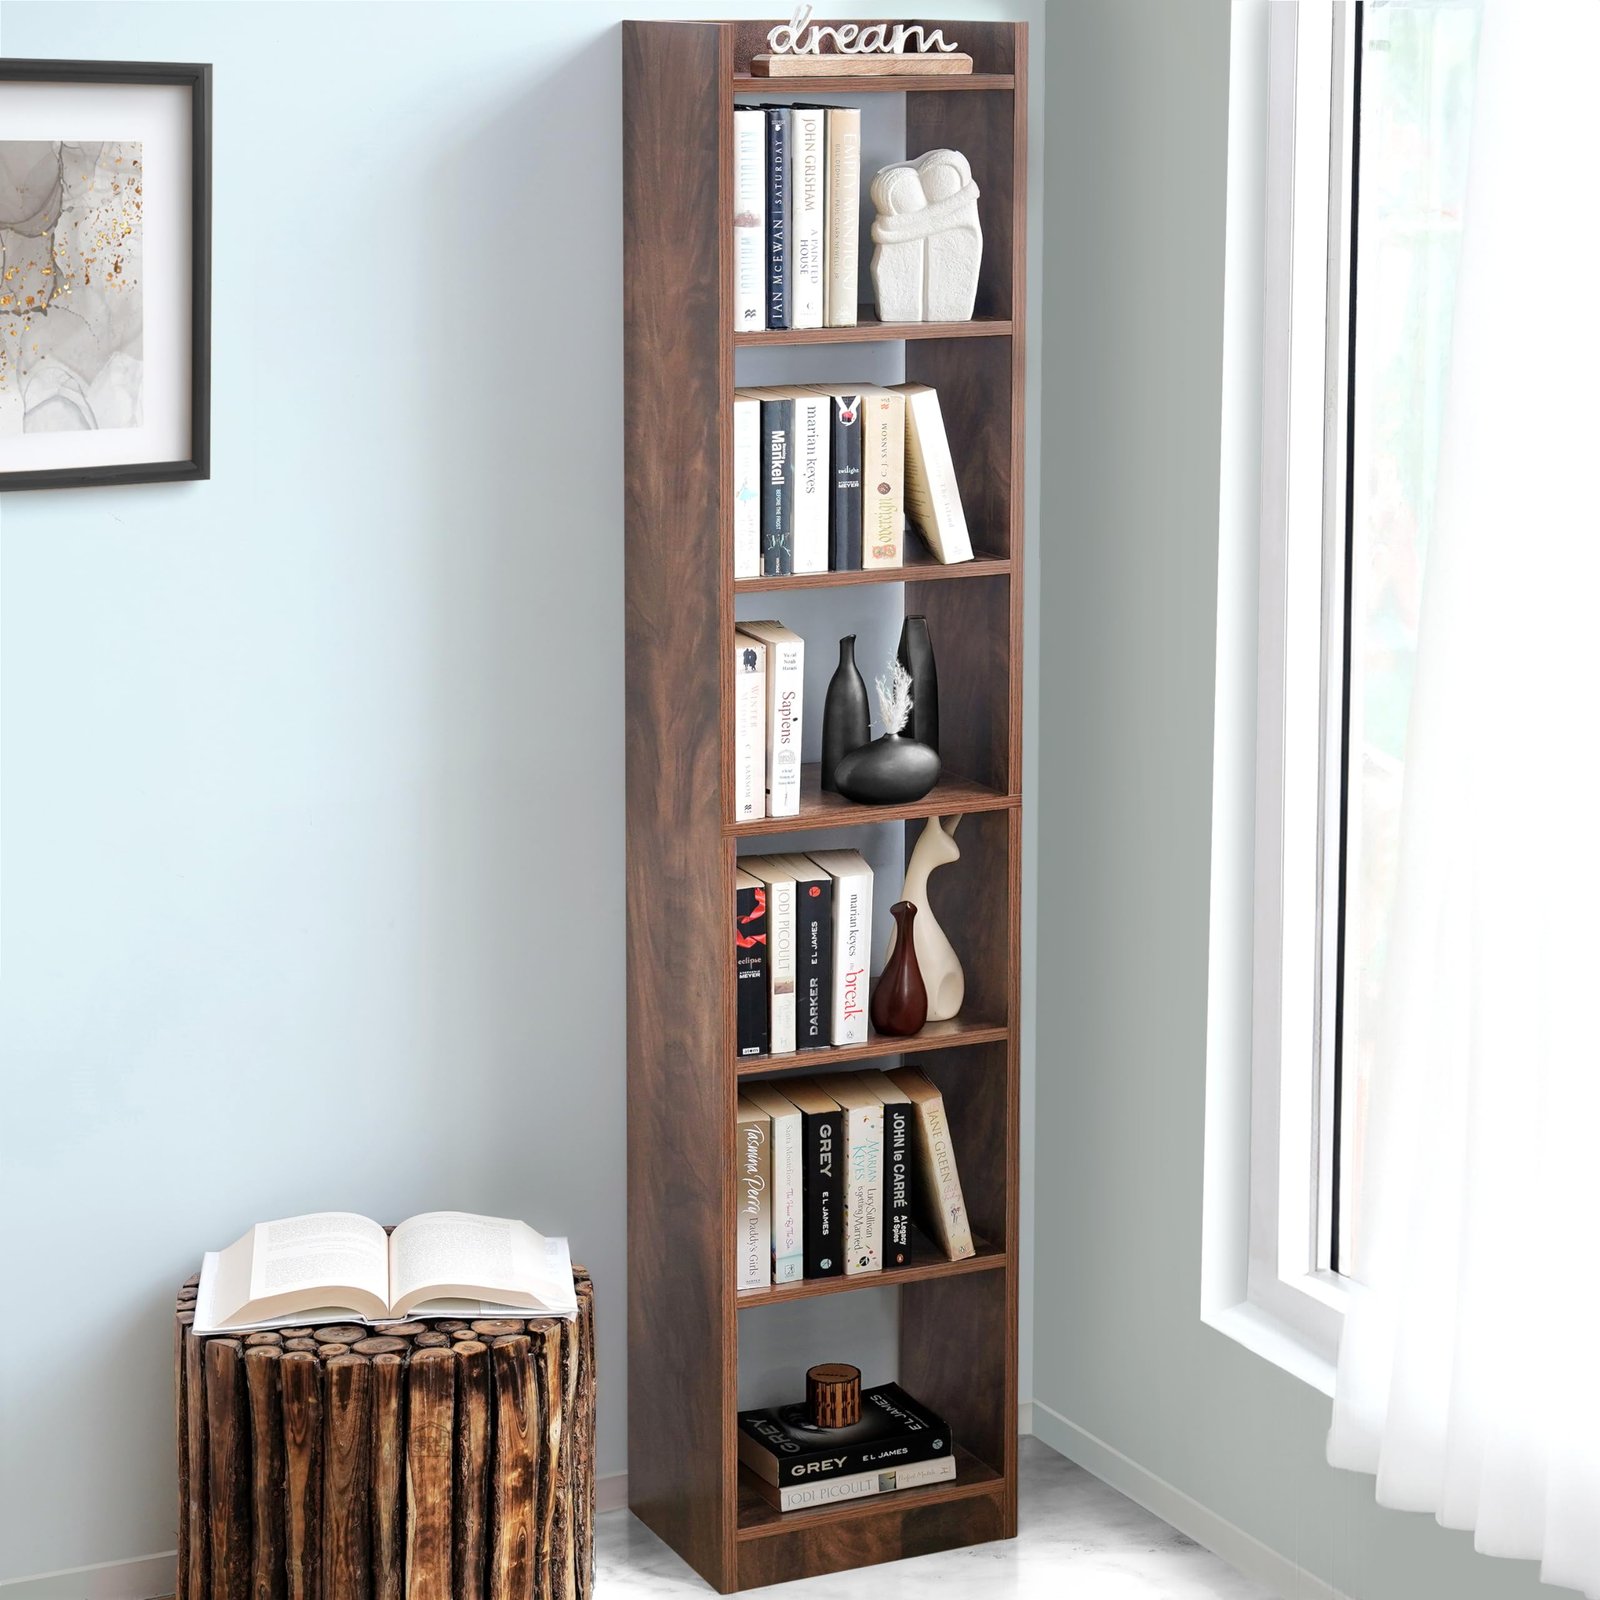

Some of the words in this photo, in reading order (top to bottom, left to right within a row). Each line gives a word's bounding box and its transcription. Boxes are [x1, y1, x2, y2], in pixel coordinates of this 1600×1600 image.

[767, 4, 958, 54] dream
[802, 118, 816, 152] JOHN
[774, 139, 783, 205] SATURDAY
[843, 133, 857, 192] EMPTY
[804, 155, 816, 211] GRISHAM
[810, 228, 818, 236] A
[772, 218, 784, 285] McEWAN
[799, 239, 809, 275] HOUSE
[810, 239, 819, 284] PAINTED
[773, 292, 783, 319] IAN
[807, 406, 819, 455] marian
[771, 430, 785, 485] Mankell
[838, 465, 859, 475] twilight
[803, 458, 818, 494] keyes
[778, 691, 796, 744] Sapiens
[777, 888, 790, 916] JODI
[849, 893, 859, 928] marian
[777, 921, 790, 971] PICOULT
[846, 929, 860, 957] keyes
[738, 957, 762, 970] eclipse
[809, 977, 819, 1036] DARKER
[844, 969, 864, 1021] break
[893, 1112, 905, 1148] JOHN
[743, 1124, 765, 1174] Tasmina
[819, 1124, 832, 1177] GREY
[852, 1145, 867, 1181] KEYES
[865, 1138, 879, 1183] MARIAN
[893, 1150, 905, 1161] le
[934, 1140, 952, 1184] GREEN
[742, 1175, 765, 1215] Perry
[854, 1190, 865, 1215] getting
[893, 1164, 908, 1208] CARRÉ
[747, 1217, 759, 1252] Daddy's
[892, 1224, 900, 1243] Spies
[899, 1222, 908, 1246] Legacy
[748, 1254, 759, 1276] Girls
[870, 1394, 907, 1418] JAMES
[904, 1417, 914, 1425] L
[745, 1419, 801, 1453] GREY
[908, 1423, 923, 1431] E
[791, 1456, 848, 1477] GREY
[862, 1454, 869, 1462] E
[878, 1447, 909, 1459] JAMES
[786, 1490, 815, 1508] JODI
[820, 1478, 873, 1500] PICOULT
